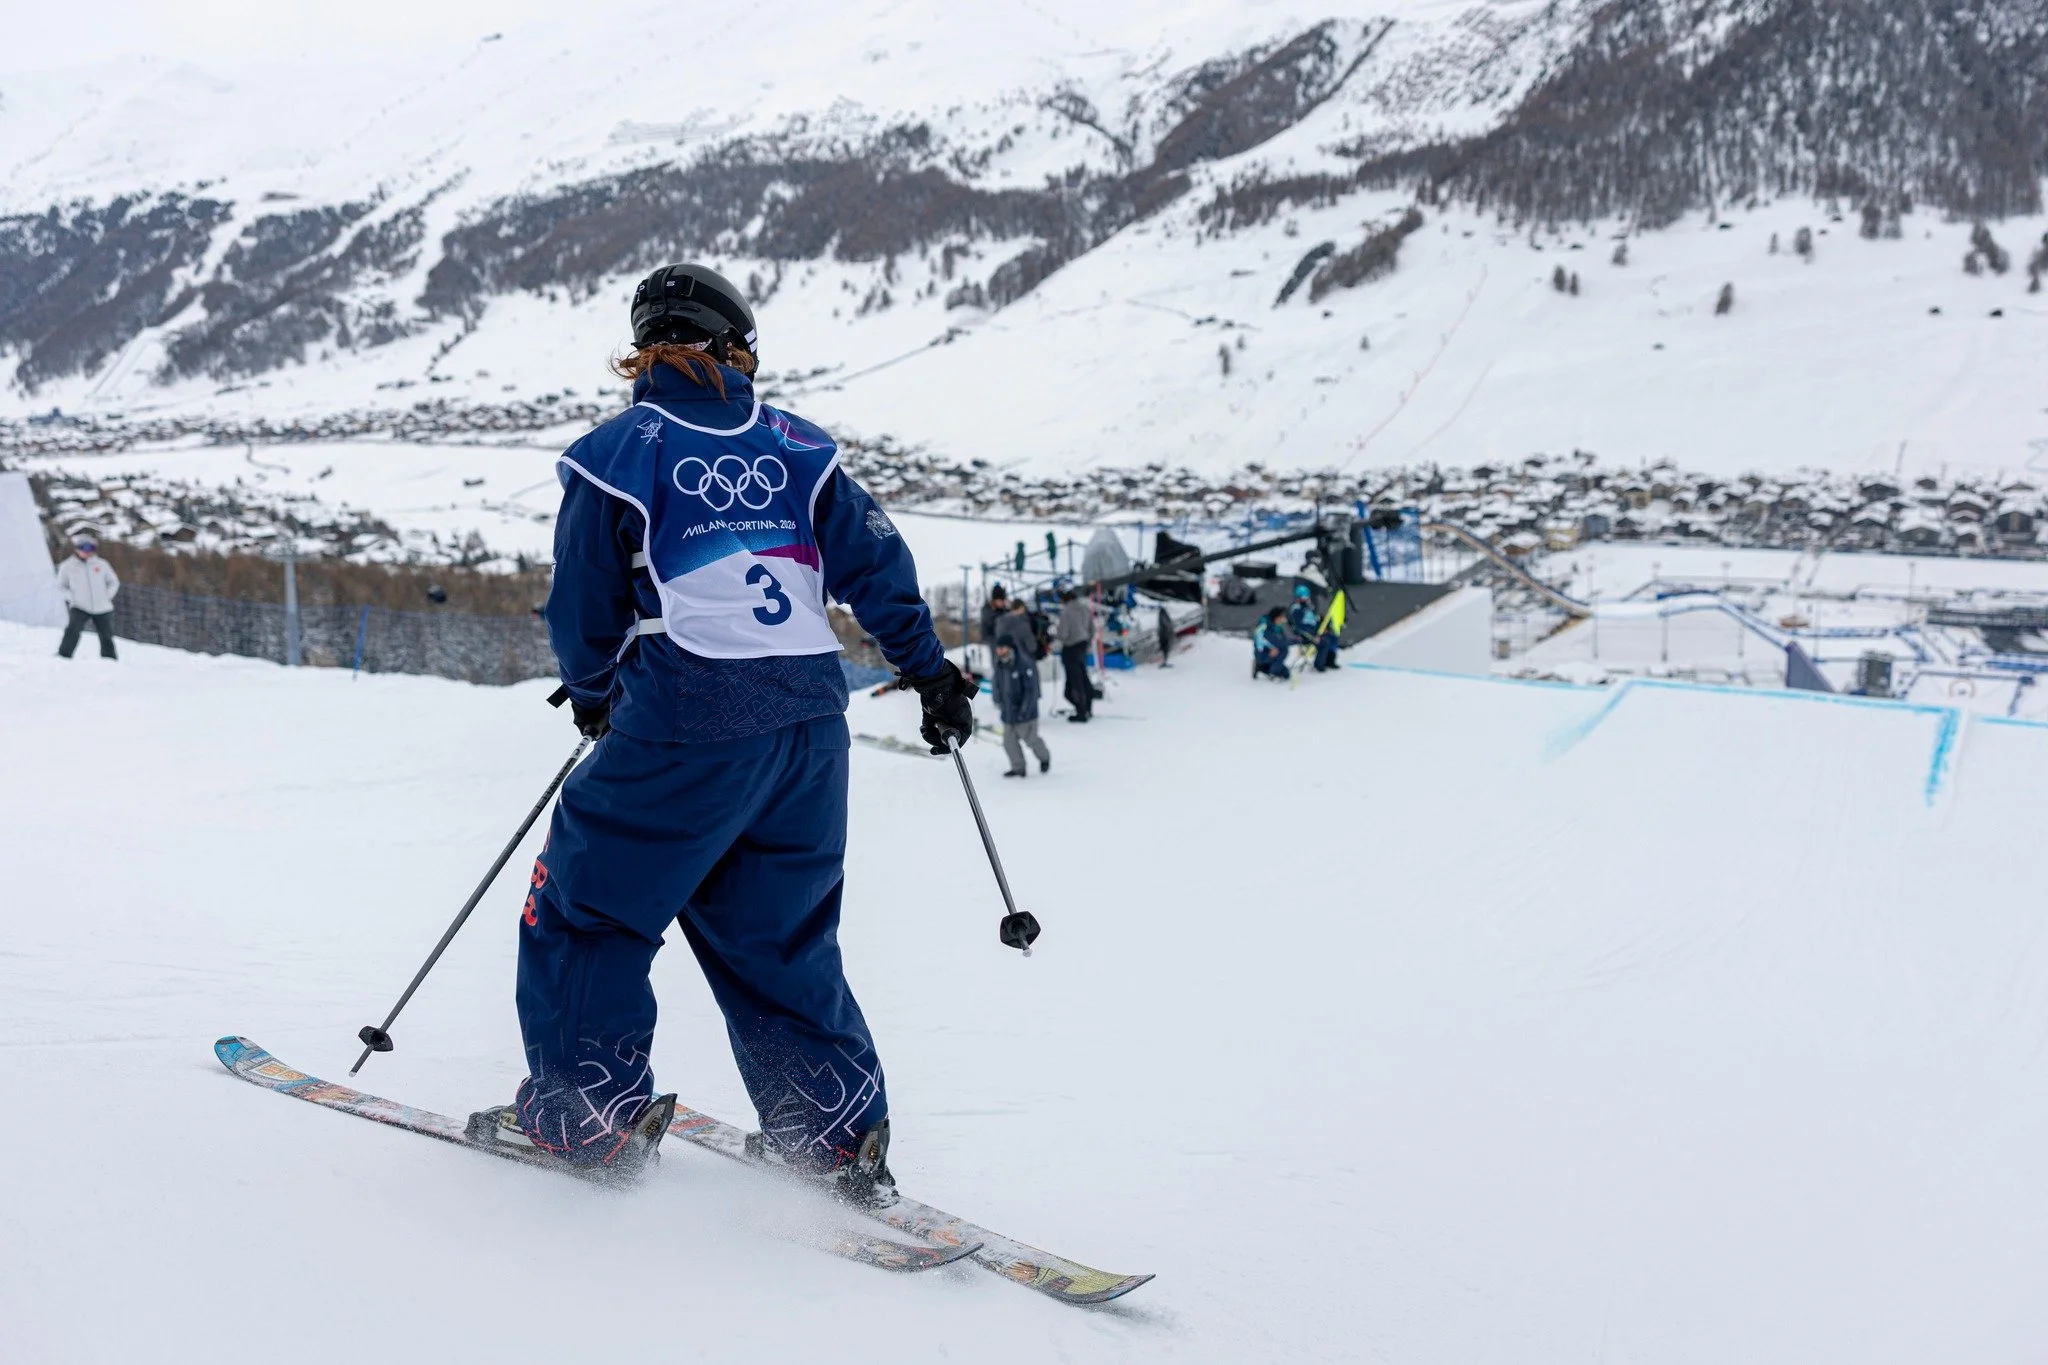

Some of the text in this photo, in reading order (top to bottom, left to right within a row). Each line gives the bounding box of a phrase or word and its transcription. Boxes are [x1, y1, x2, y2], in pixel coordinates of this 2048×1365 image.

[682, 519, 797, 539] MILAN CORTINA 2026
[745, 563, 792, 625] 3
